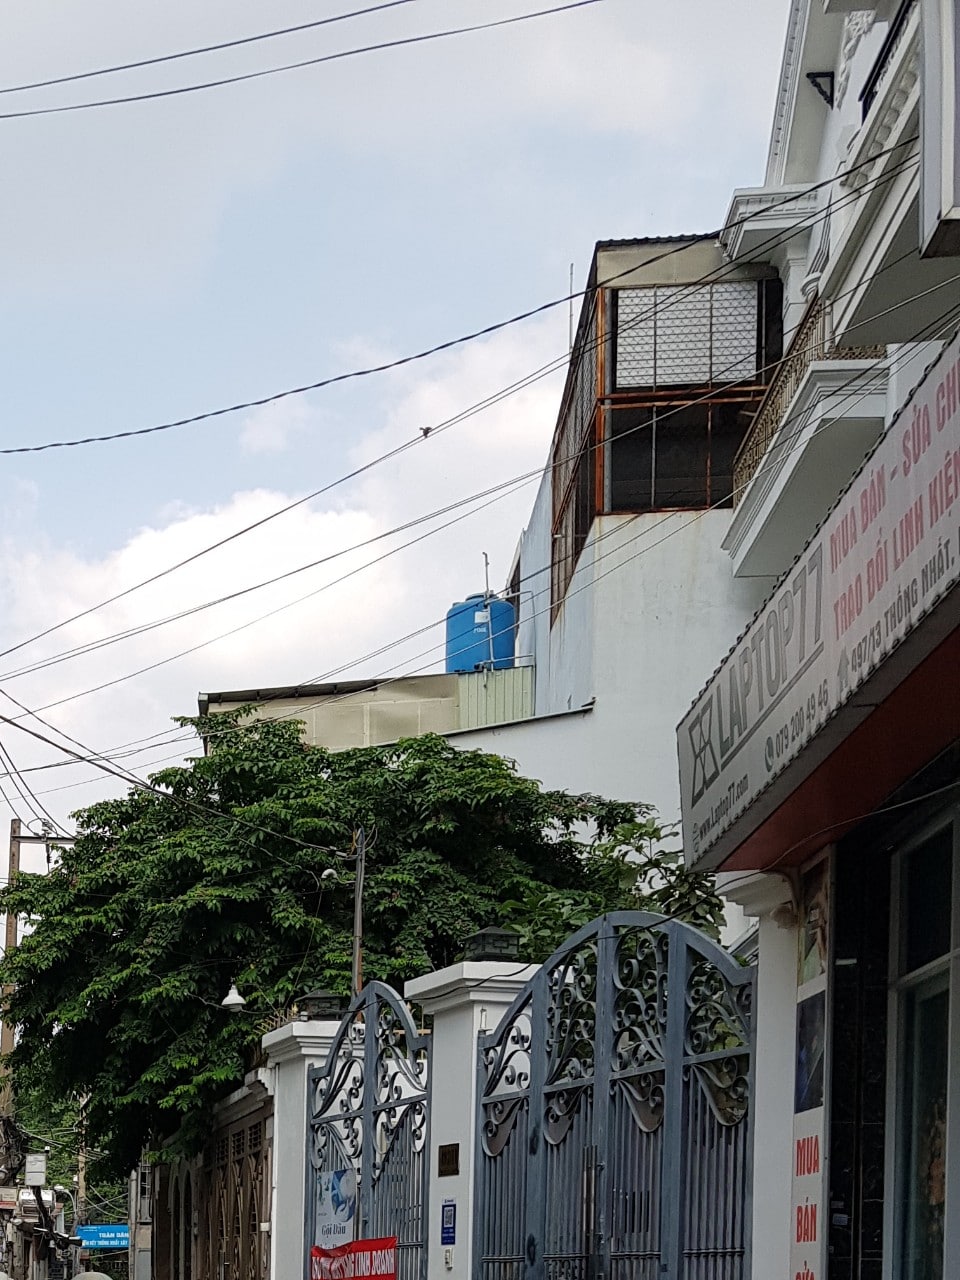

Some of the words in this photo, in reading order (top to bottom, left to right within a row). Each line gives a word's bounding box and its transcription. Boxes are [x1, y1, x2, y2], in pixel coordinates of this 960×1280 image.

[830, 505, 857, 575] MUA
[860, 463, 886, 535] BÁN
[902, 403, 931, 477] SỬA
[833, 573, 863, 641] TRAO
[866, 526, 888, 604] ĐỔI
[893, 494, 924, 571] LINH
[884, 577, 919, 638] THỐNG
[716, 541, 823, 761] LAPTOP77
[775, 723, 789, 759] 079
[790, 706, 804, 742] 200
[796, 1134, 820, 1177] MUA
[796, 1196, 817, 1243] BÁN
